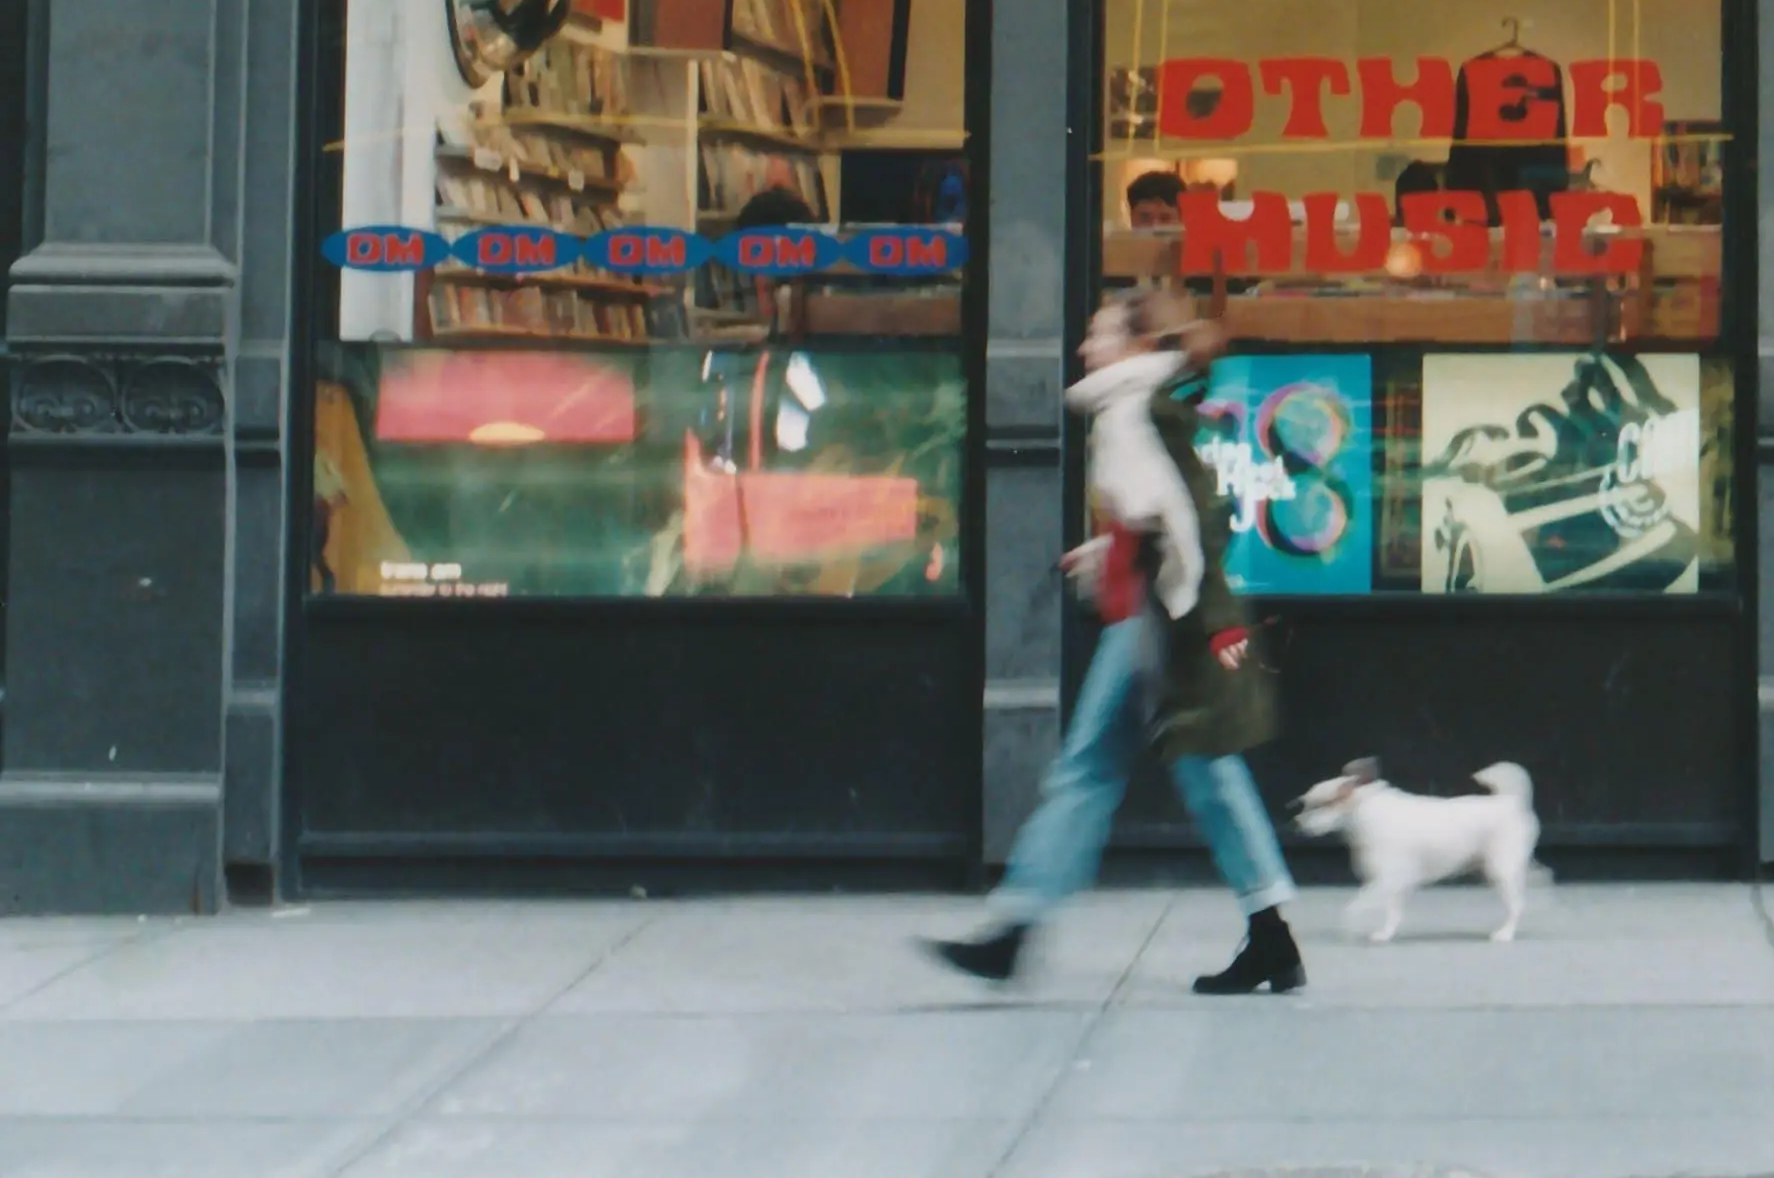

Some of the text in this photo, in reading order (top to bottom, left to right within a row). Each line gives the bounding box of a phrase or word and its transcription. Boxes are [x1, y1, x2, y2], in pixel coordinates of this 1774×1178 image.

[1155, 55, 1665, 140] OTHER
[346, 233, 947, 268] OM OM OM OM OM
[1177, 189, 1644, 274] MUSIC
